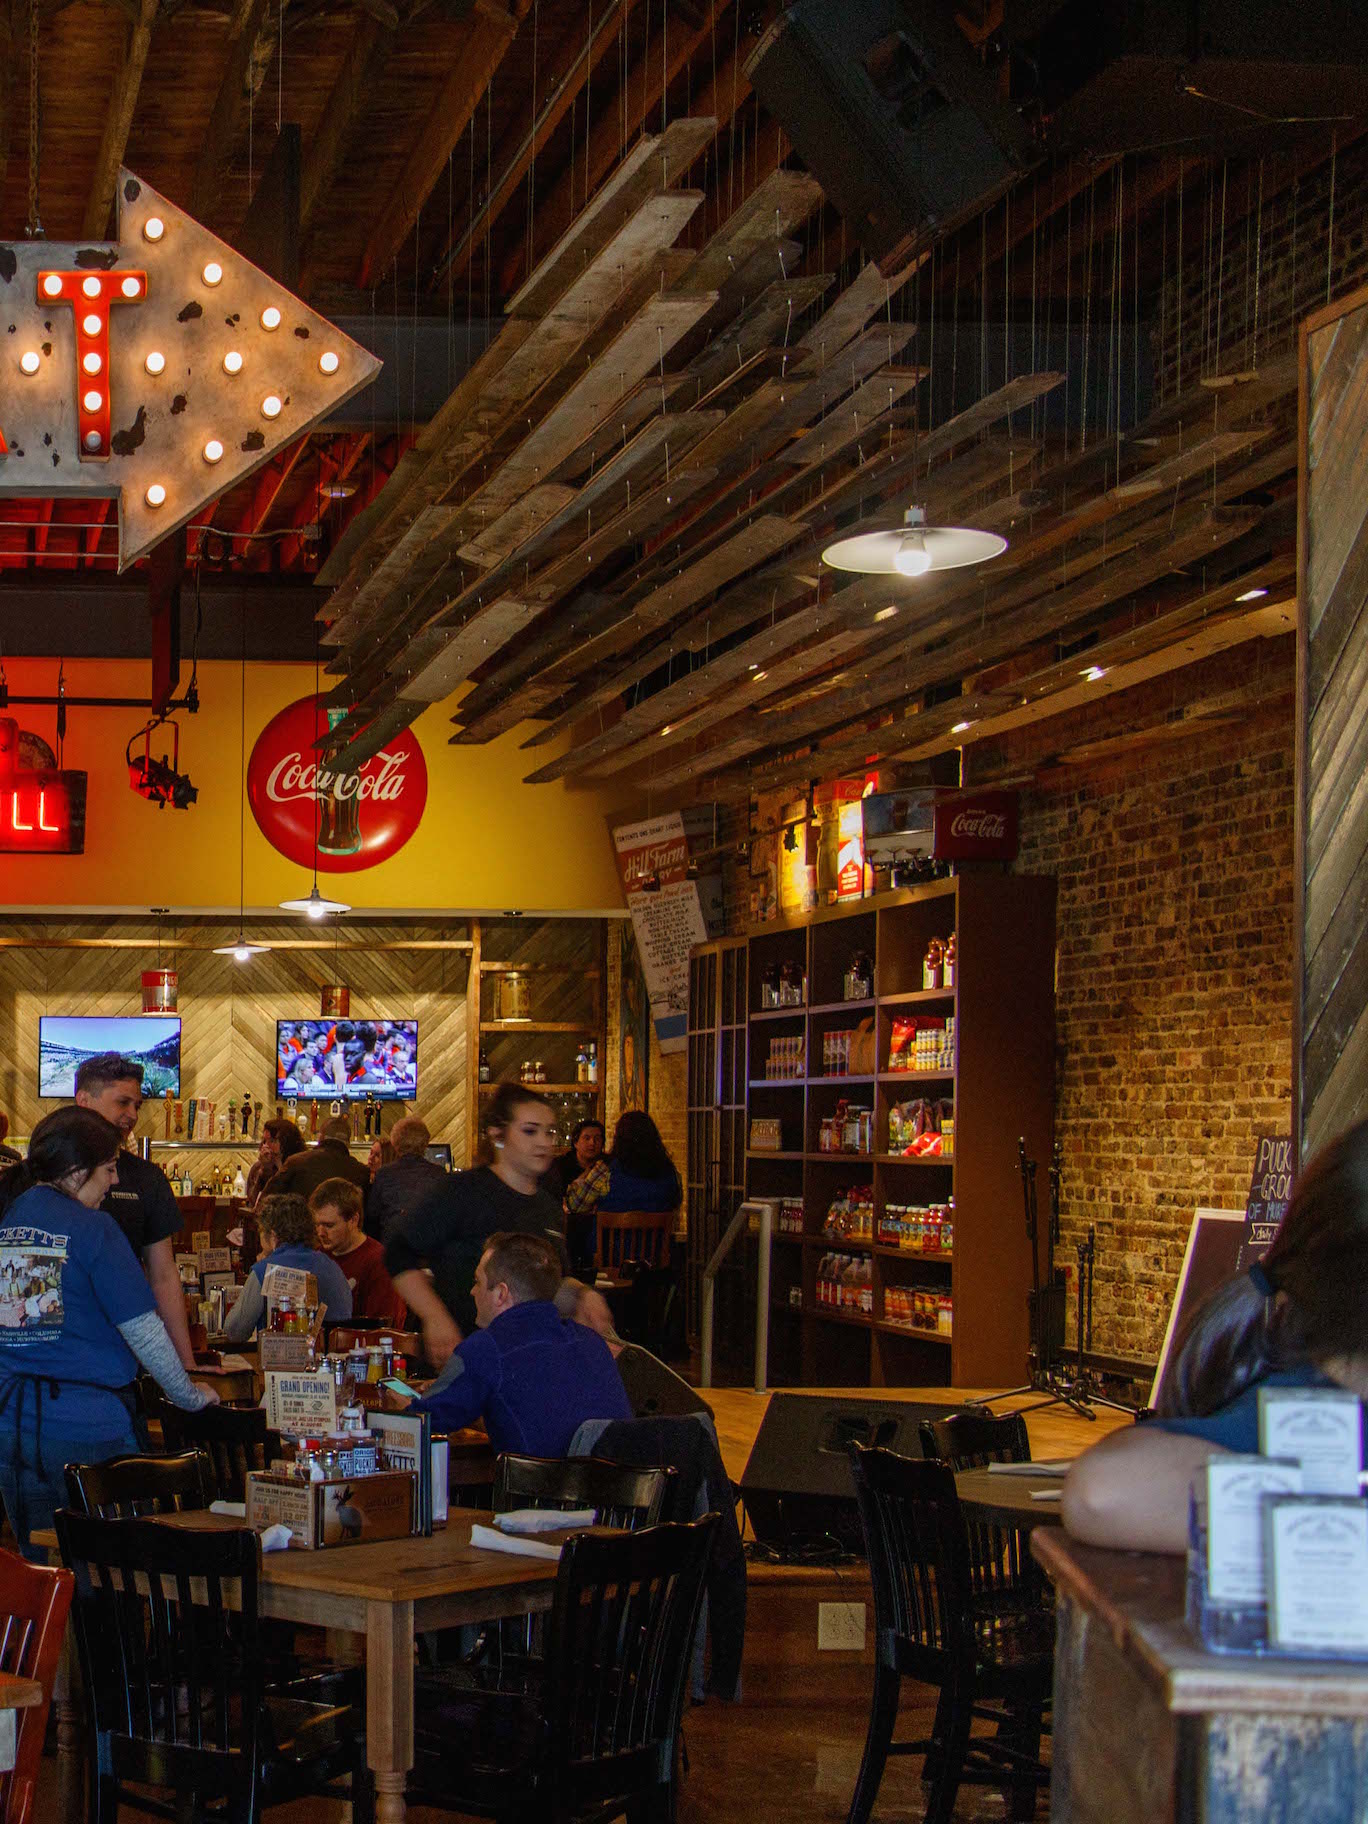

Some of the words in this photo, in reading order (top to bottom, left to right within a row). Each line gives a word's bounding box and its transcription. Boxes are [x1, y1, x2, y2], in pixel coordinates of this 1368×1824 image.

[1258, 1138, 1292, 1173] PUCK
[1248, 1202, 1262, 1220] OF
[280, 1380, 300, 1393] GRAND
[302, 1381, 330, 1394] OPENING!
